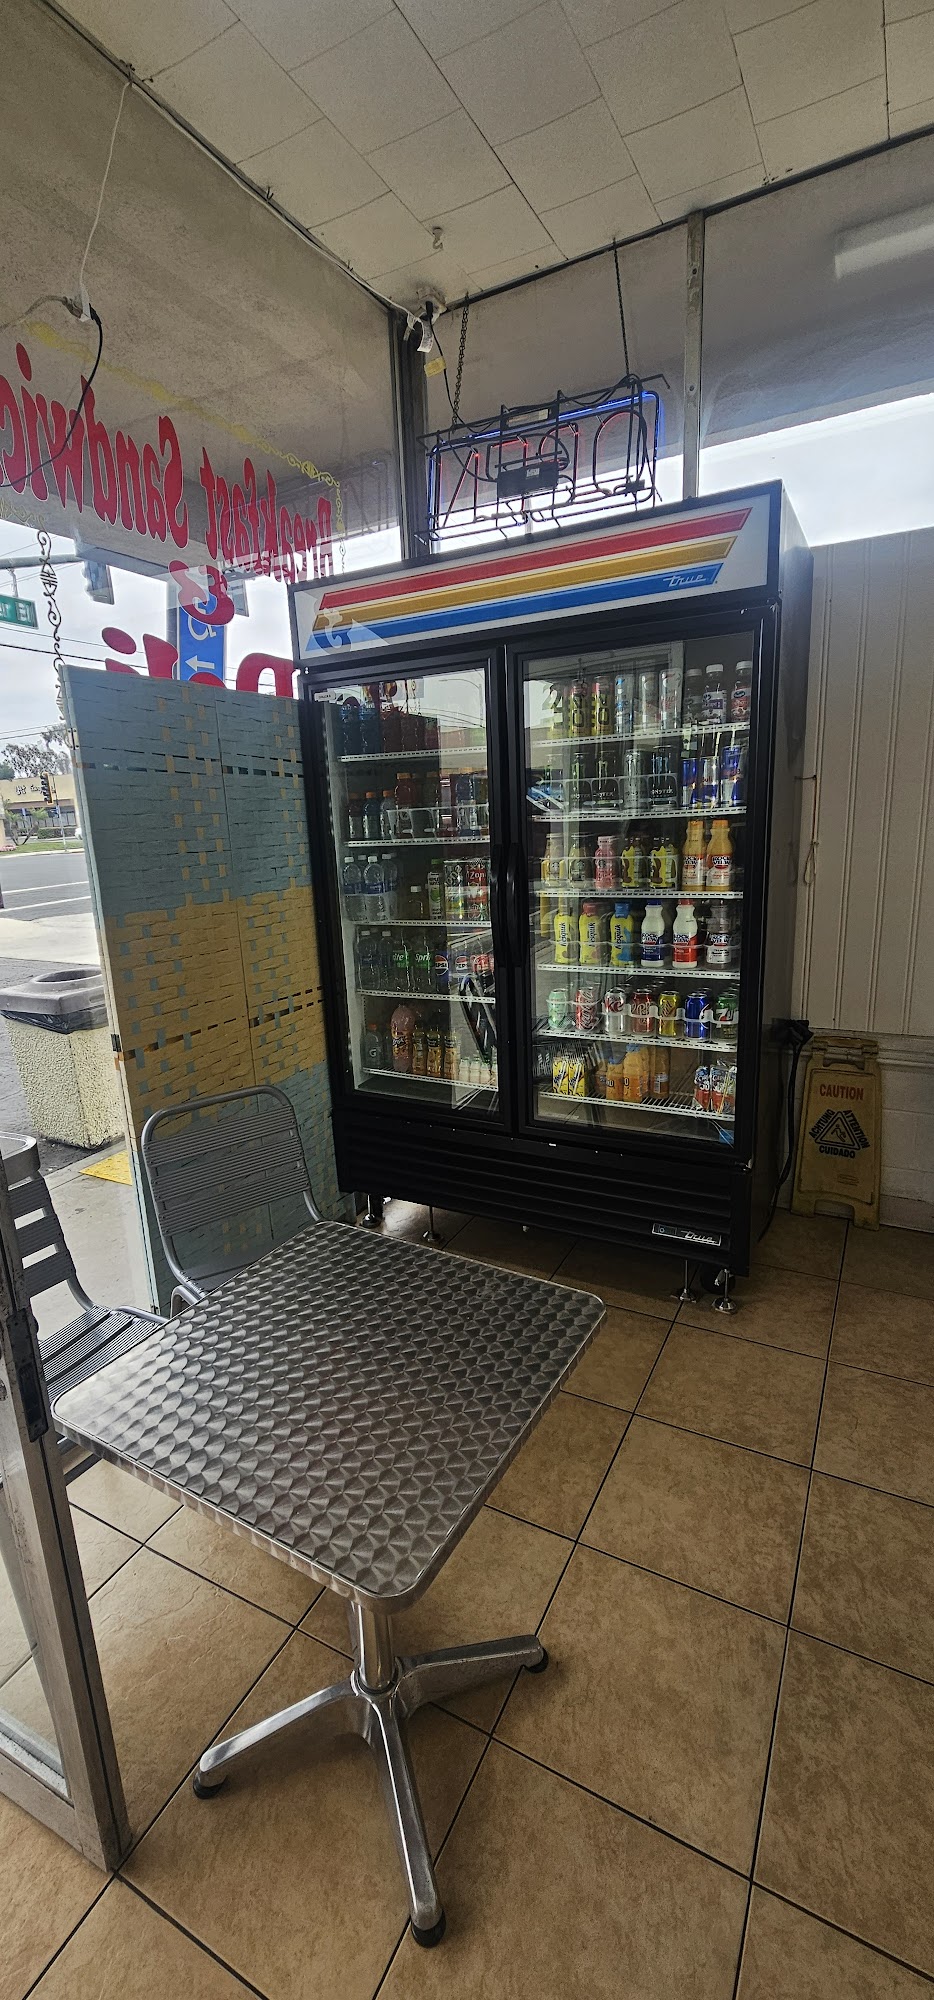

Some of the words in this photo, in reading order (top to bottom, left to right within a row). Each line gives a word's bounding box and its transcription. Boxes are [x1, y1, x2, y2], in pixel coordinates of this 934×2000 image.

[663, 575, 707, 587] true
[820, 1084, 864, 1100] CAUTION
[808, 1108, 836, 1139] ACHTUNG
[843, 1109, 871, 1149] ATTENTION
[819, 1145, 855, 1159] CUIDADO
